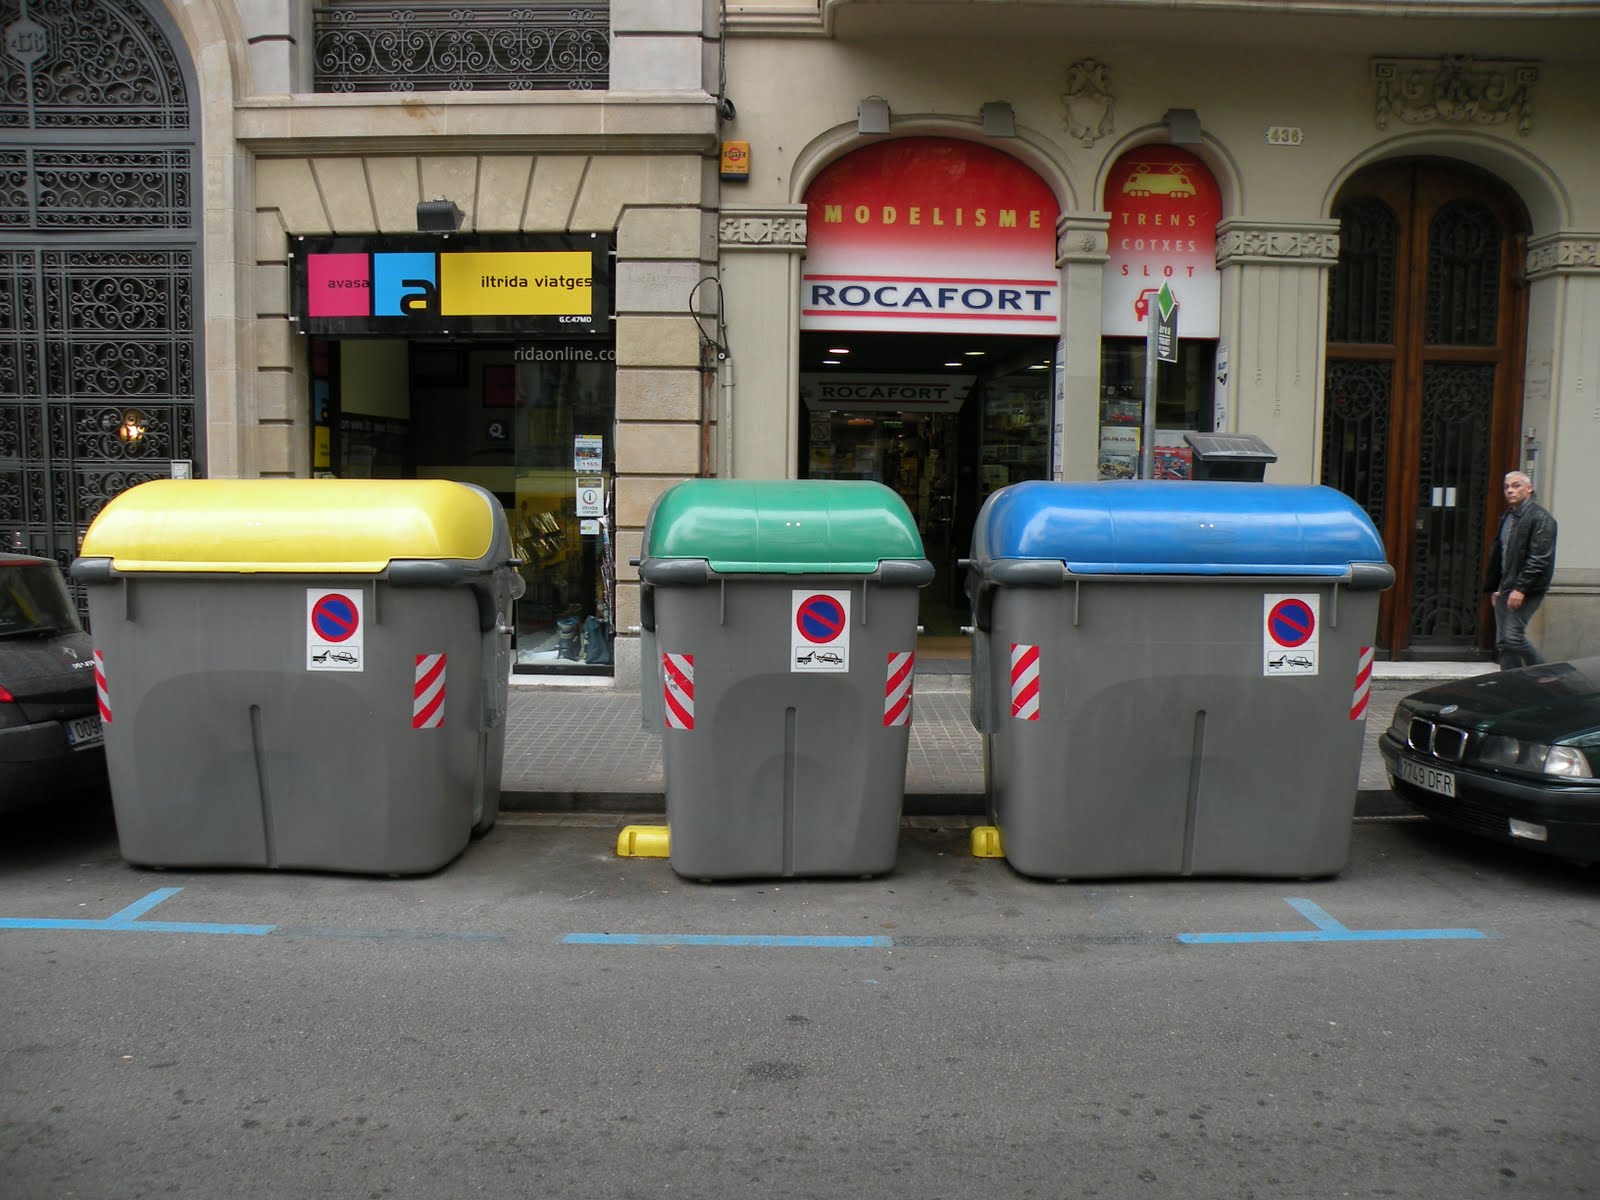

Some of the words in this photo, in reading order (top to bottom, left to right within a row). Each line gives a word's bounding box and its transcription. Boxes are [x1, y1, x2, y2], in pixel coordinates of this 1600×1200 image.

[1270, 128, 1299, 143] 436
[824, 205, 1041, 228] MODELISME
[1122, 213, 1196, 227] TRENS
[1121, 238, 1196, 252] COTXES
[1121, 264, 1194, 278] SLOT
[327, 279, 371, 289] avasa
[481, 275, 528, 288] iltrida
[535, 275, 593, 290] viatges
[811, 284, 1051, 311] ROCAFORT
[822, 386, 949, 399] ROCAFORT
[1402, 760, 1424, 784] 7749
[1428, 770, 1452, 793] DFR
